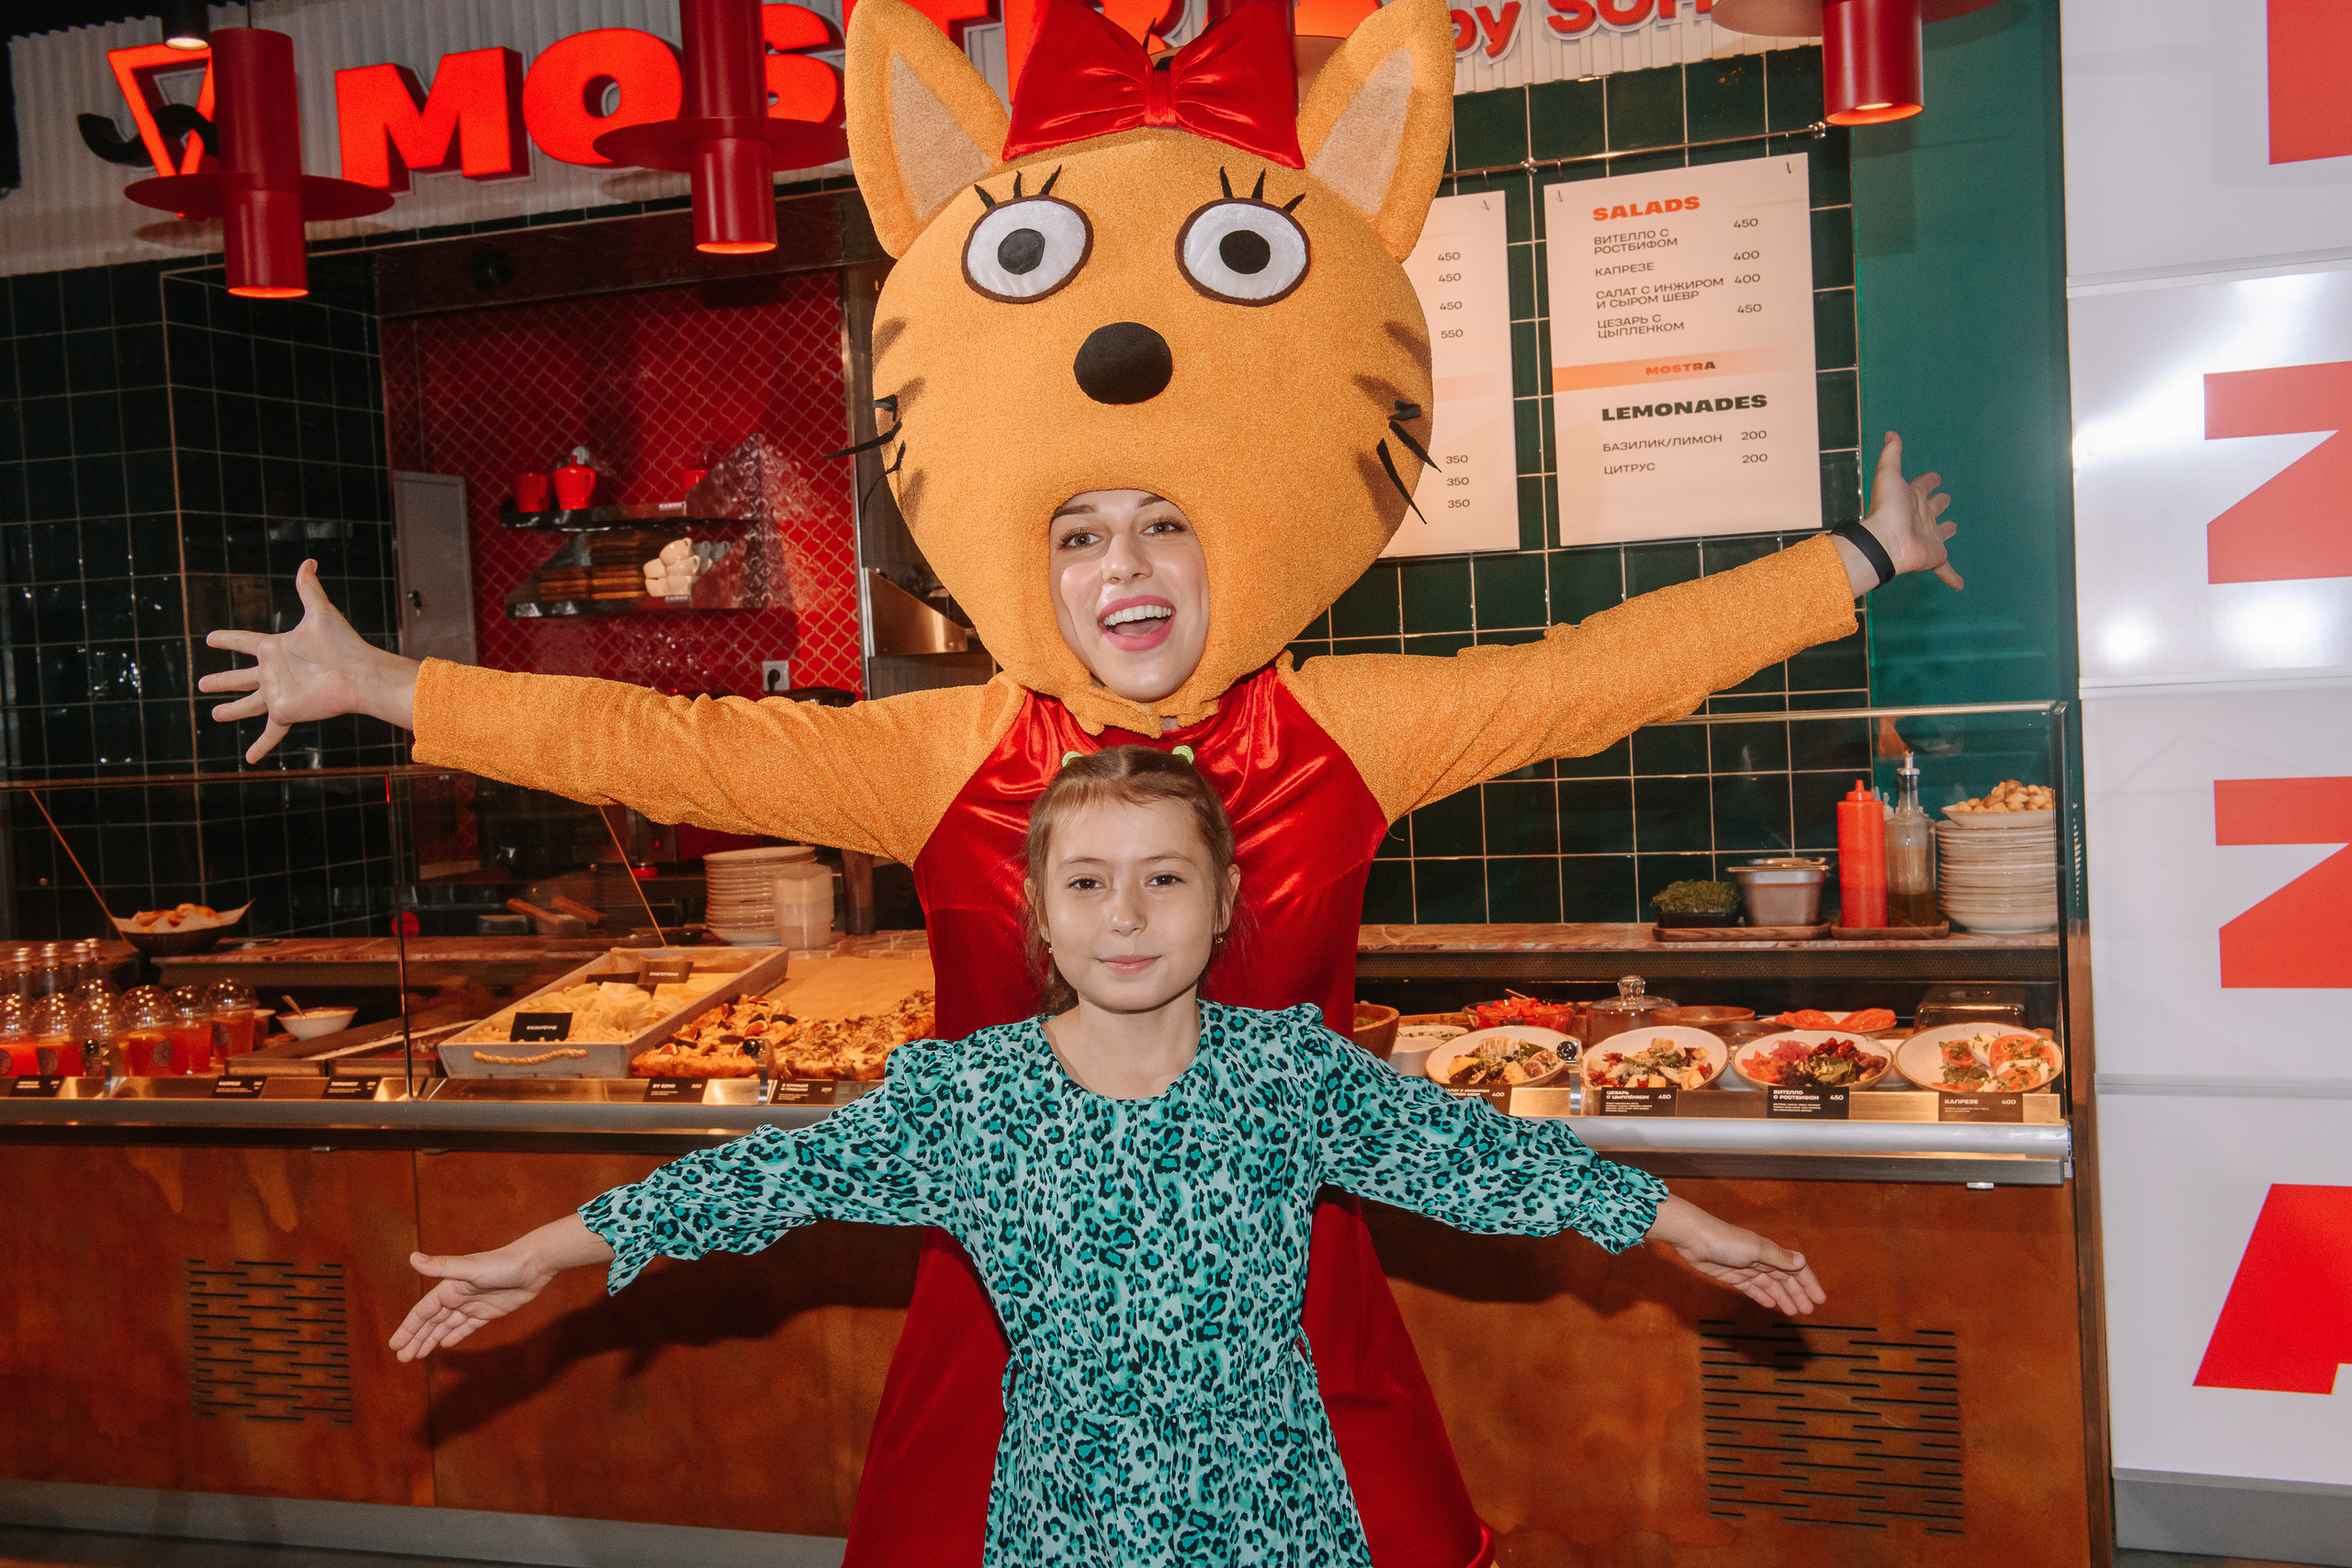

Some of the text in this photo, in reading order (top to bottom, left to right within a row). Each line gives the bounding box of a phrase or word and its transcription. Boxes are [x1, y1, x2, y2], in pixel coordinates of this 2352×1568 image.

[1593, 197, 1701, 220] SALADS
[1734, 219, 1759, 228] 450
[1594, 228, 1669, 245] ВИТЕЛЛО С
[1594, 237, 1679, 254] РОСТБИФОМ
[1438, 253, 1461, 261] 450
[1734, 251, 1760, 260] 400
[1596, 263, 1654, 276] КАПРЕЗЕ
[1439, 273, 1462, 282] 450
[1735, 274, 1761, 283] 400
[1596, 277, 1724, 299] САЛАТ С ИНЖИРОМ
[1597, 290, 1700, 310] И СЫРОМ ШЕВР
[1440, 301, 1463, 310] 450
[1737, 304, 1762, 313] 450
[1598, 313, 1662, 329] ЦЕЗАРЬ С
[1442, 330, 1464, 338] 550
[1598, 321, 1684, 339] ЦЫПЛЕНКОМ
[1645, 361, 1716, 376] MOSTRA
[1602, 395, 1768, 421] LEMONADES
[1742, 431, 1768, 440] 200
[1603, 434, 1723, 452] БАЗИЛИК/ЛИМОН
[1446, 455, 1469, 464] 350
[1743, 454, 1769, 463] 200
[1604, 463, 1656, 474] ЦИТРУС
[1447, 478, 1470, 486] 350
[1448, 500, 1471, 508] 350
